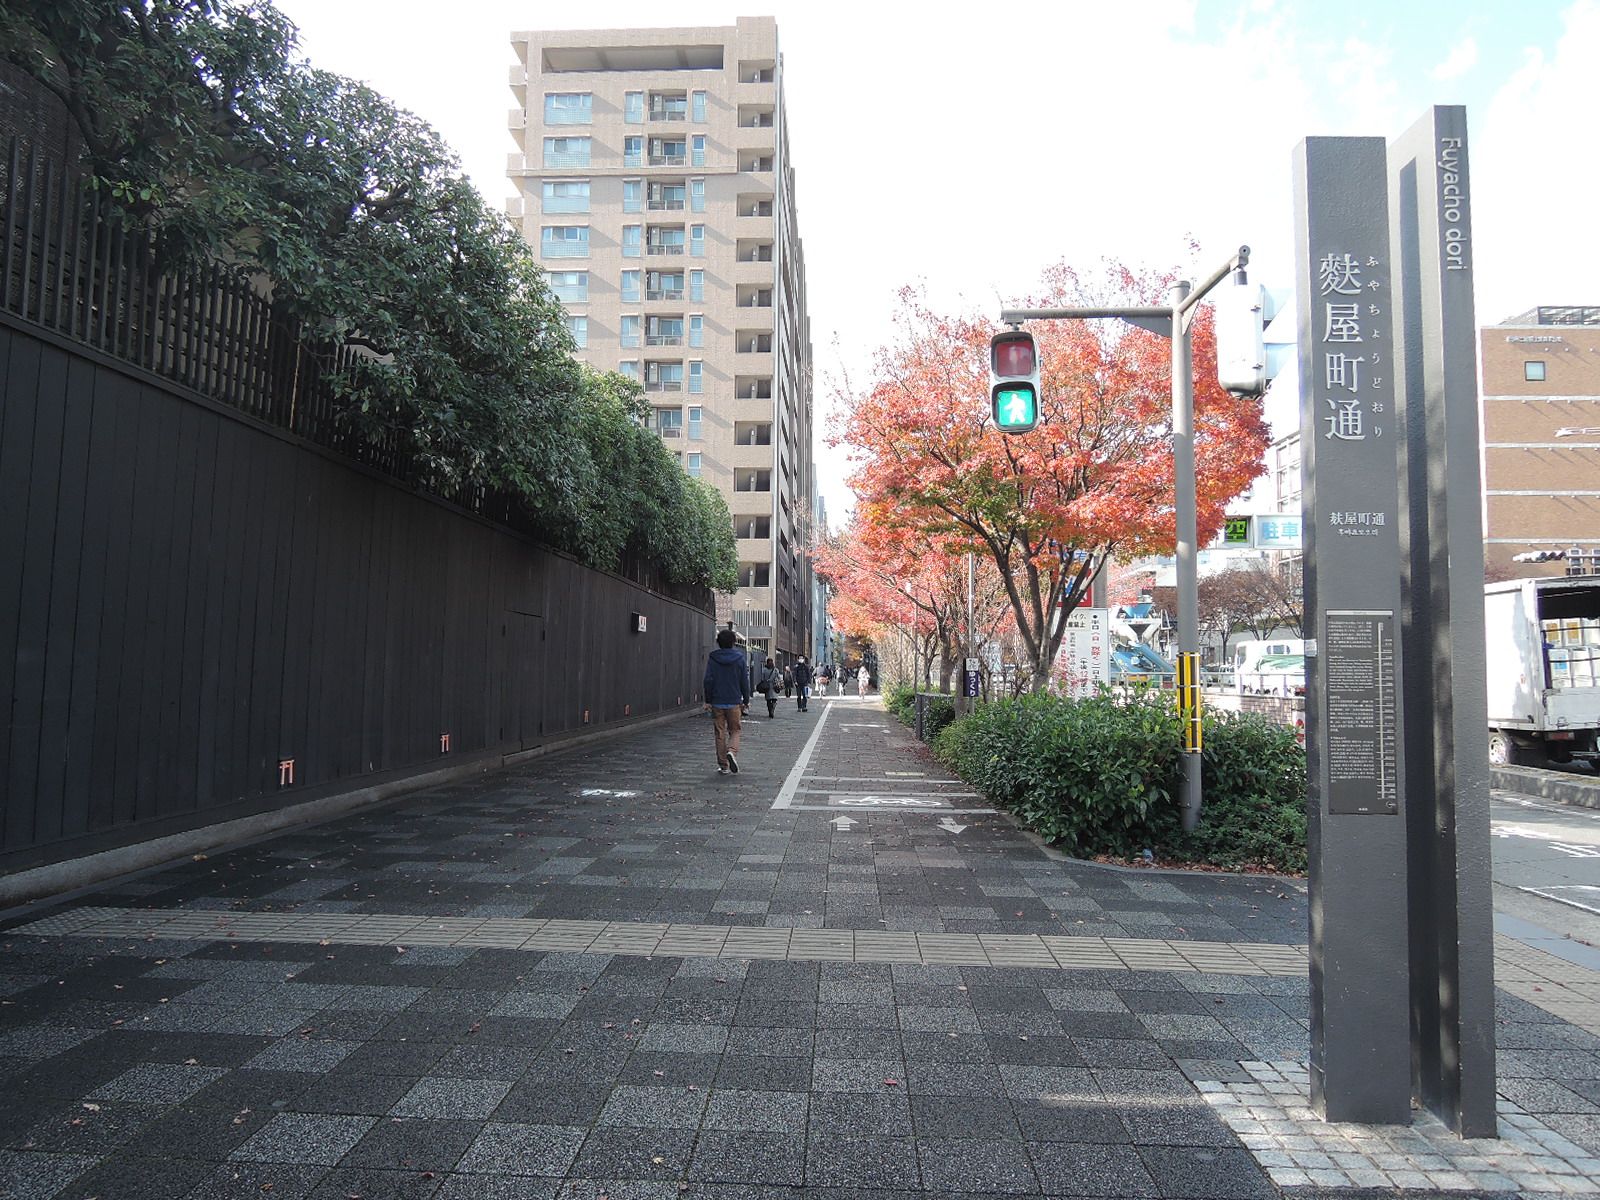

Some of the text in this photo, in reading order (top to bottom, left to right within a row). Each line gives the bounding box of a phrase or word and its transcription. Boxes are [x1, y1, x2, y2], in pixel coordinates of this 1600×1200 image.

[1438, 137, 1467, 270] Fuyacho dori
[1366, 256, 1384, 438] ふやちょうどおり
[968, 671, 976, 696] ゆっくり
